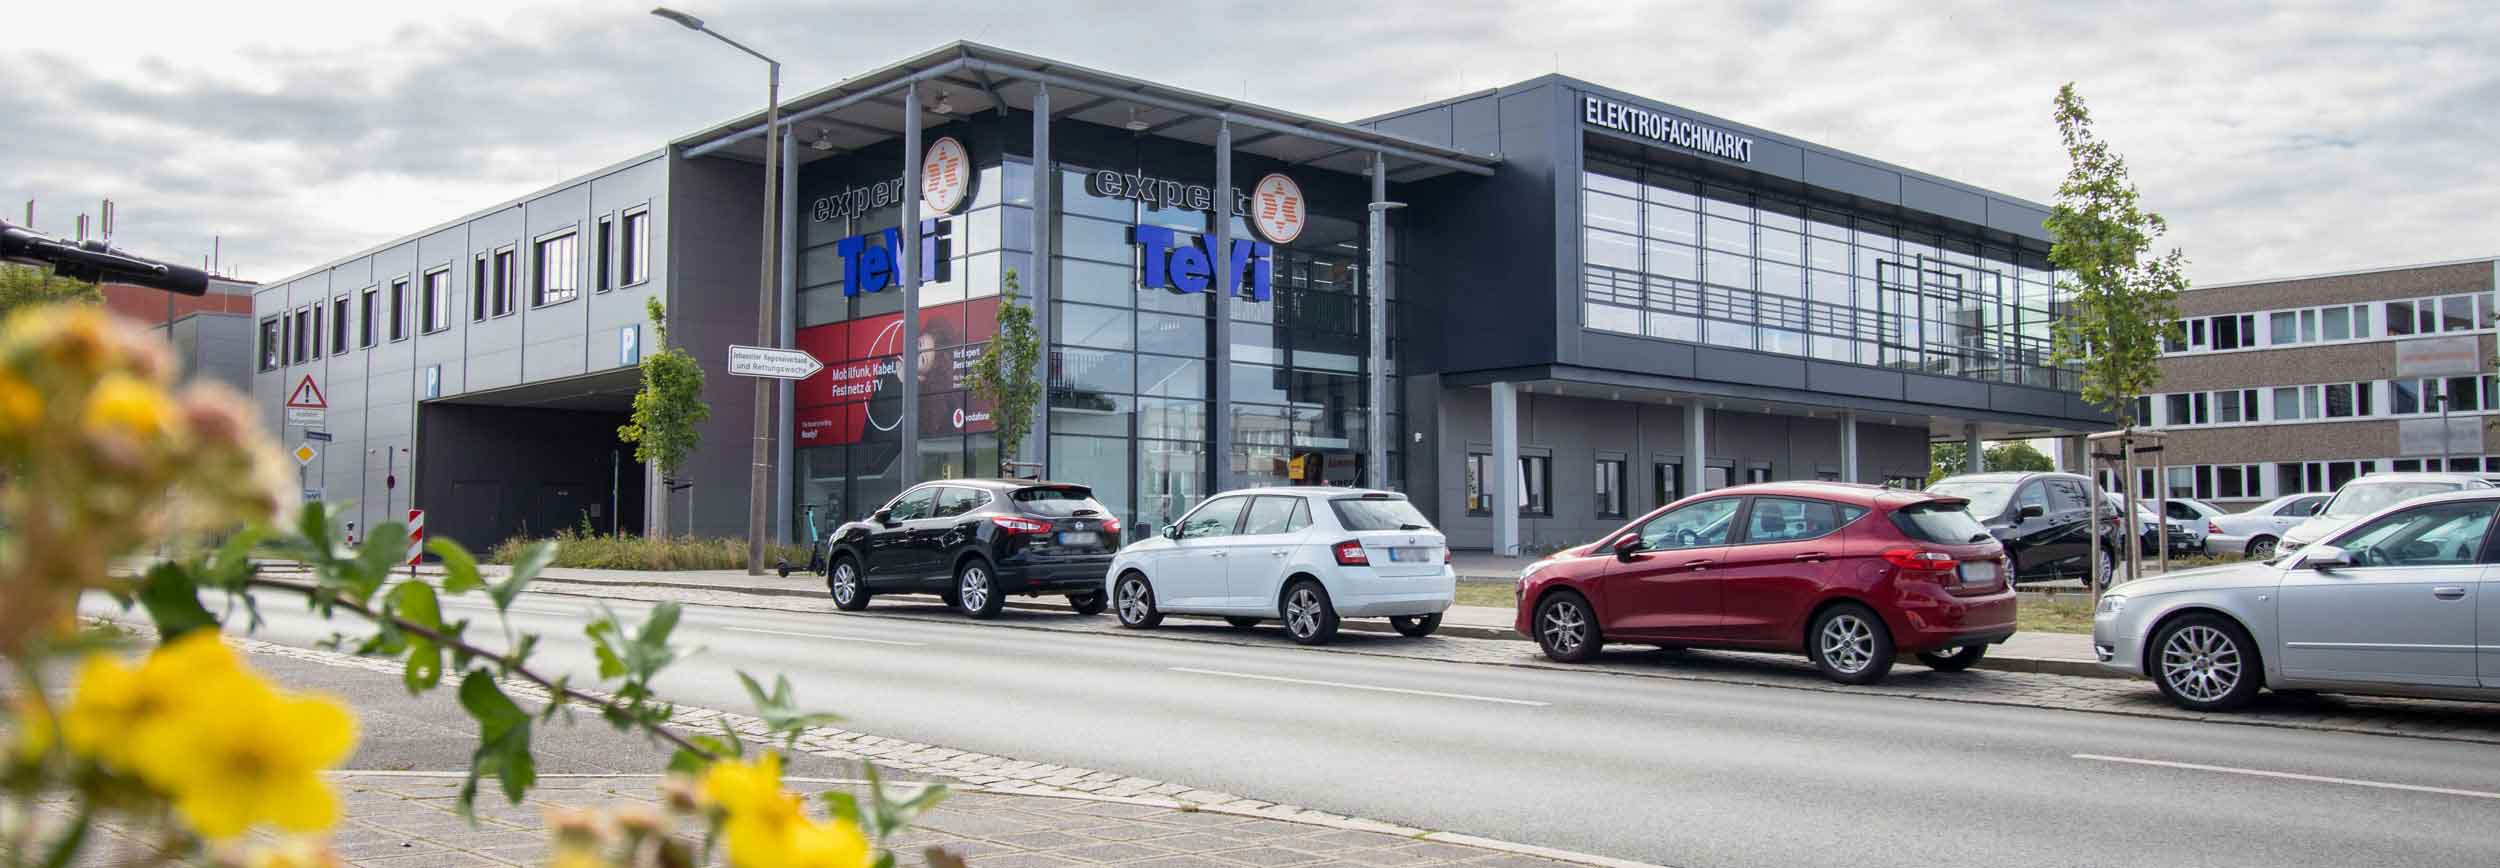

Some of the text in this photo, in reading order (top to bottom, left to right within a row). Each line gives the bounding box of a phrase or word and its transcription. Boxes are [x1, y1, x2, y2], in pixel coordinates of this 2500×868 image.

[1586, 96, 1753, 162] ELEKTROFACHMARKT
[813, 177, 904, 222] exper
[1096, 169, 1246, 216] expet
[1136, 223, 1270, 301] TeVi
[865, 380, 871, 393] &
[872, 379, 883, 393] TV
